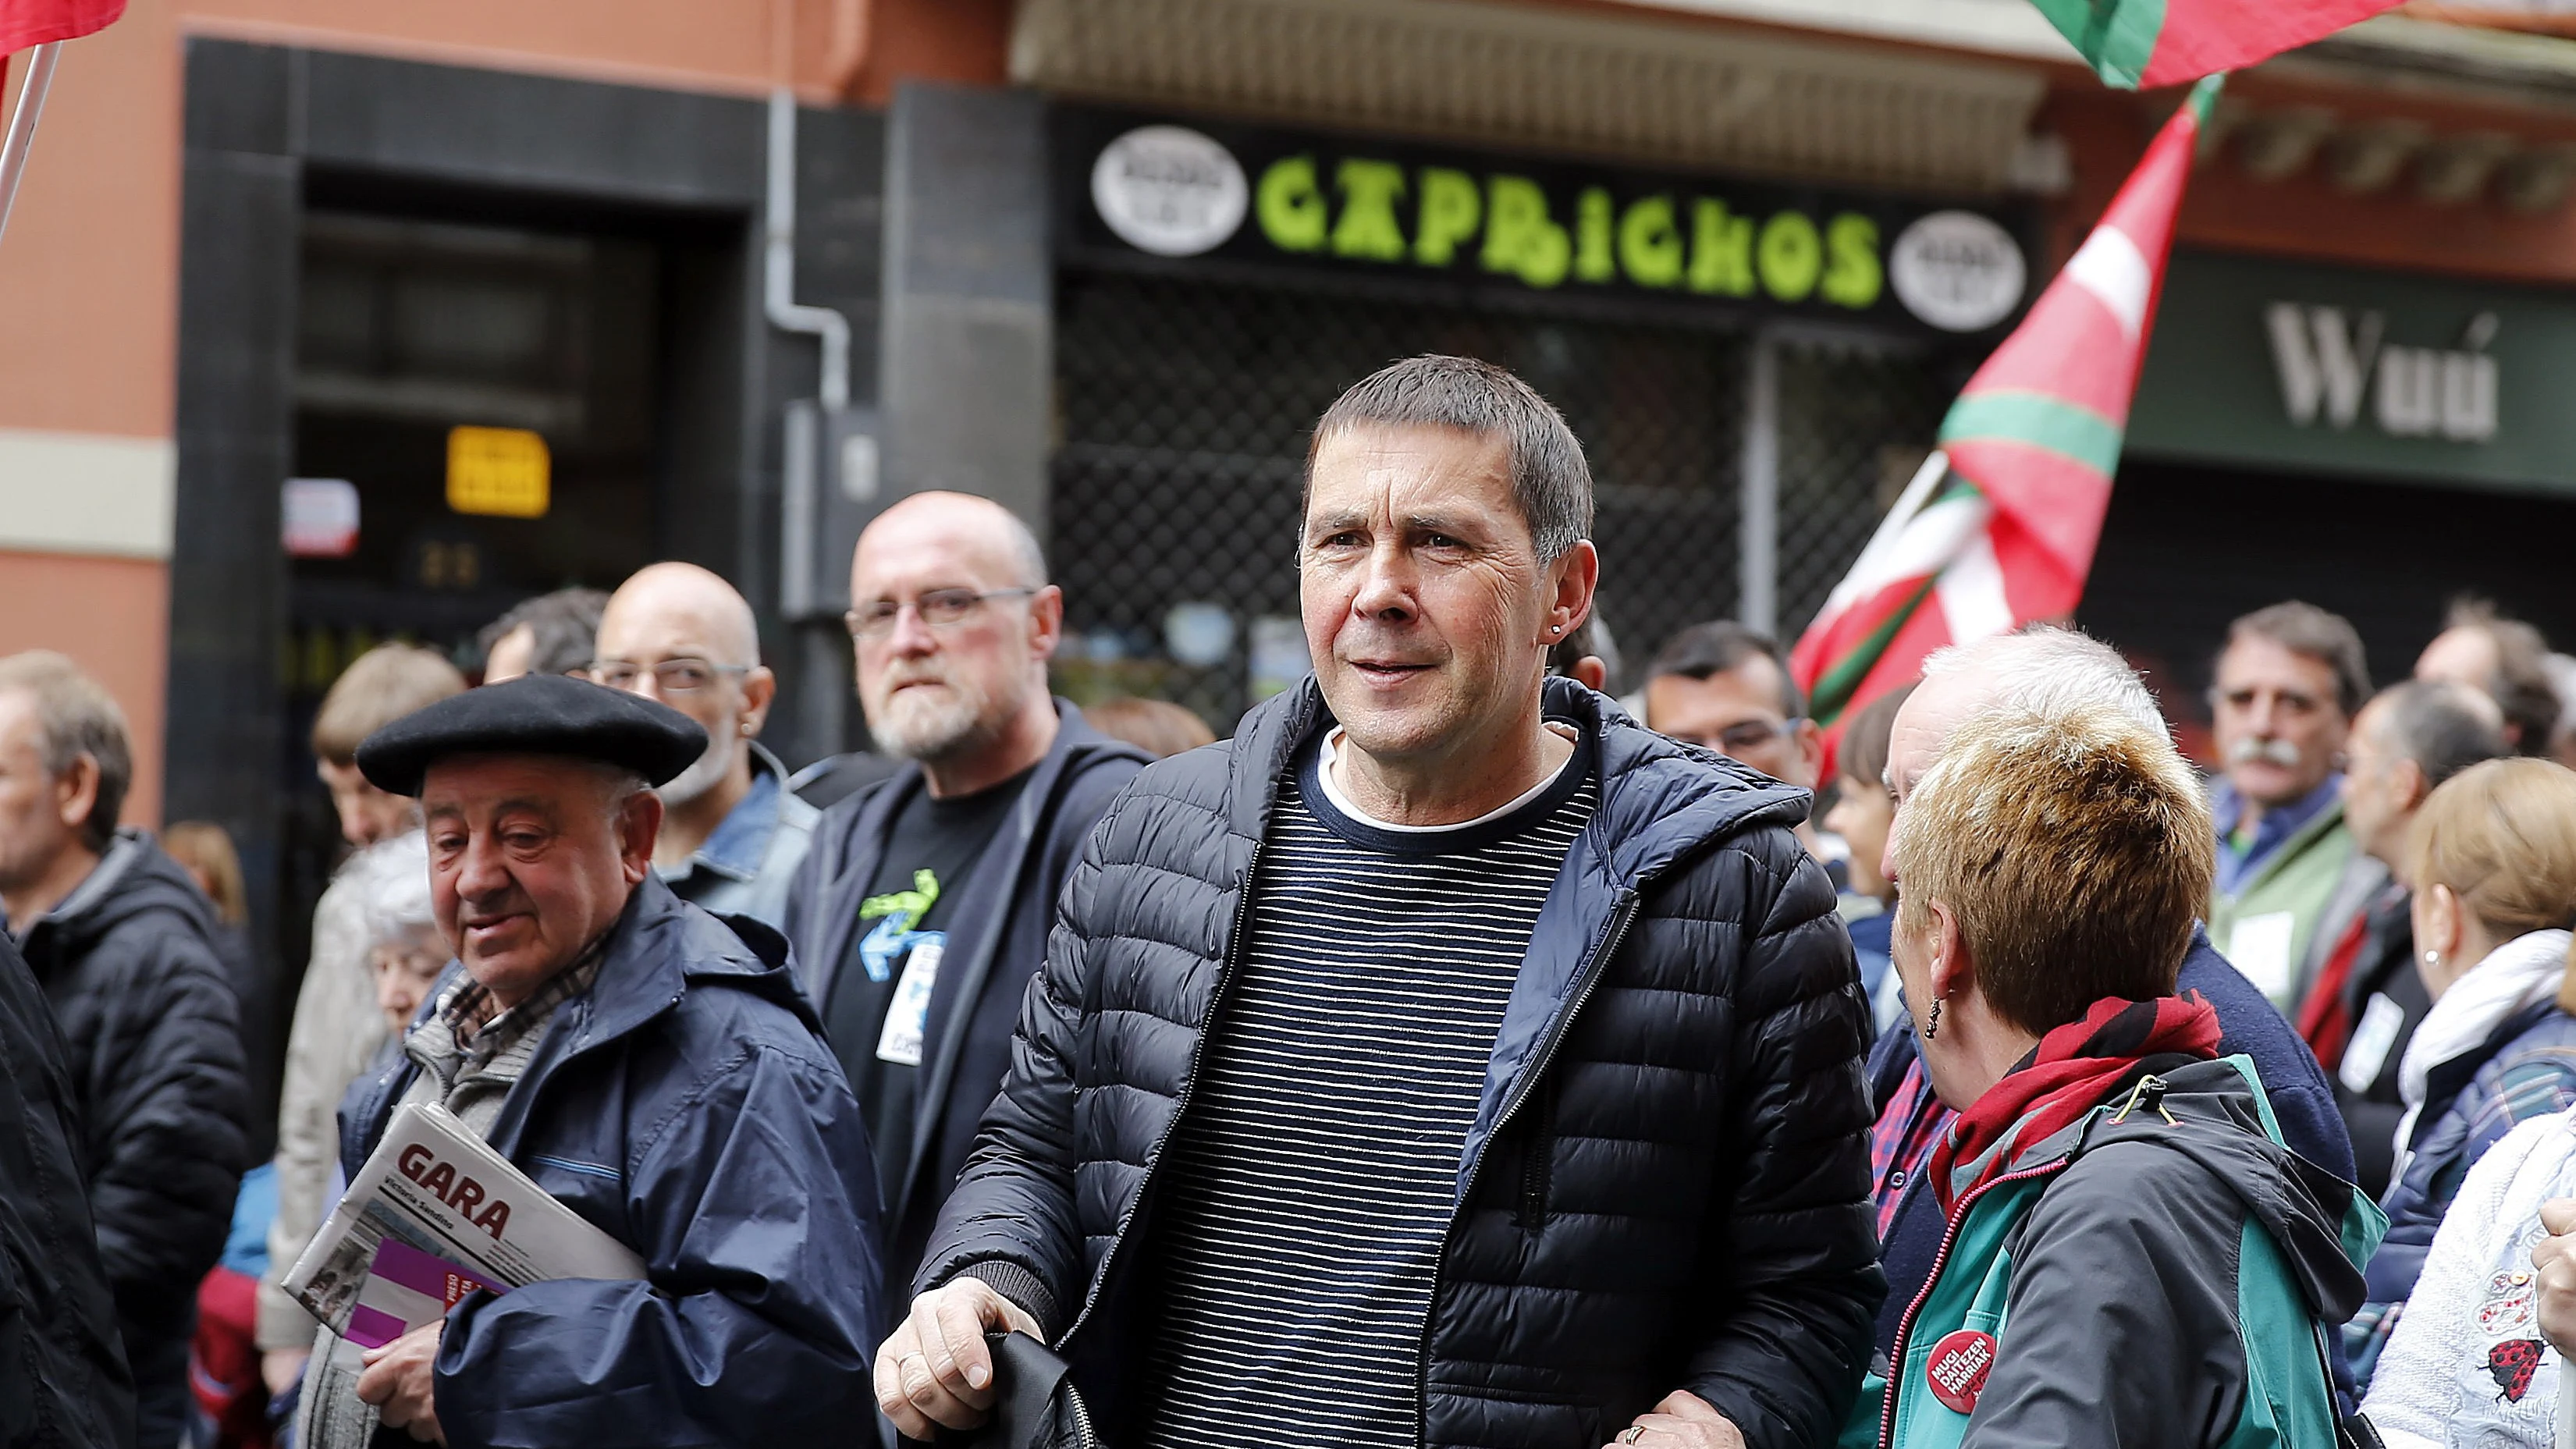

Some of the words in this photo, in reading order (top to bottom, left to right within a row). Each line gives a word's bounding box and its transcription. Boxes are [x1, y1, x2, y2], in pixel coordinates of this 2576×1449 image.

[2269, 301, 2499, 442] Wuú
[385, 1175, 417, 1204] Victoria
[418, 1201, 454, 1230] Sandino
[398, 1143, 510, 1241] GARA
[1931, 1348, 1961, 1380] MUGI
[1939, 1337, 1987, 1388] DAITEZEN
[1947, 1348, 1992, 1395] HARRIAK
